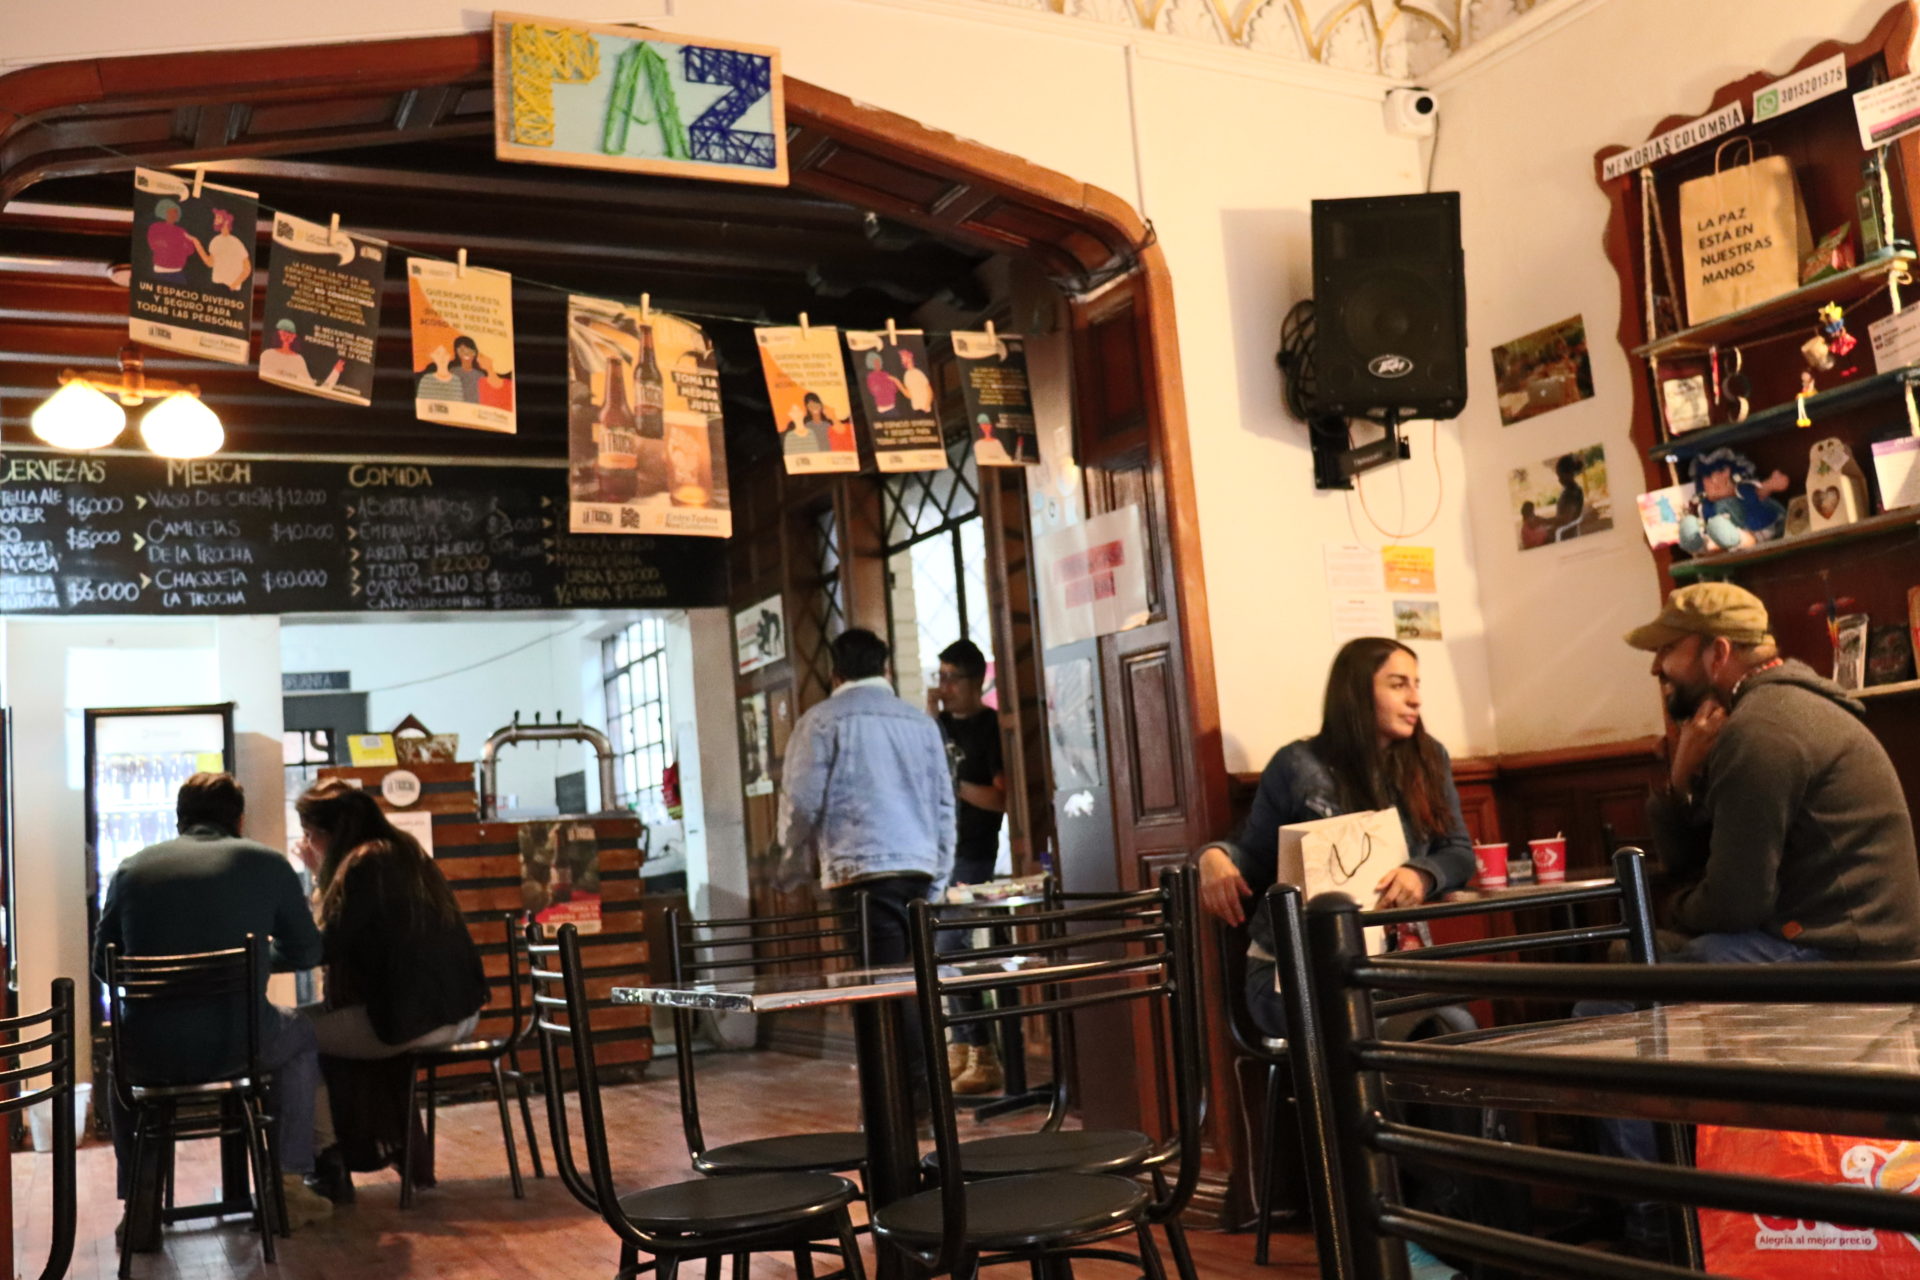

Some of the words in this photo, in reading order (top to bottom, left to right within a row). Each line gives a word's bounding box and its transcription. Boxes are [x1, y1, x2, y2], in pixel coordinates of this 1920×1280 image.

[511, 23, 777, 169] PAZ
[1781, 66, 1842, 103] 3013201375
[1605, 137, 1671, 177] MEMORIAS
[1674, 107, 1742, 150] COLOMBIA
[1698, 218, 1714, 231] LA
[1719, 207, 1746, 225] PAZ
[1735, 222, 1753, 238] EN
[1701, 235, 1772, 267] NUESTRAS
[1703, 260, 1755, 286] MANOS
[139, 281, 153, 292] UN
[156, 284, 199, 301] ESPACIO
[202, 293, 245, 310] DIVERSO
[154, 294, 160, 303] Y
[164, 297, 204, 311] SEGURO
[207, 305, 231, 317] PARA
[137, 300, 169, 315] TODAS
[172, 308, 189, 319] LAS
[674, 372, 704, 386] TOMA
[705, 376, 719, 389] LA
[690, 400, 721, 413] JUSTA
[167, 461, 251, 487] MERCH
[349, 463, 433, 488] COMIDA
[148, 489, 190, 508] VASO
[196, 490, 221, 507] DE
[147, 514, 240, 544] CAMISETAS
[148, 544, 171, 564] DE
[175, 545, 191, 564] LA
[194, 542, 254, 565] TROCHA
[155, 568, 249, 590] CHAQUETA
[366, 562, 419, 579] TINTO
[163, 592, 181, 608] LA
[184, 590, 247, 608] TROCHA
[1796, 1234, 1804, 1244] al
[1808, 1235, 1836, 1247] mejor
[1839, 1236, 1872, 1247] precio
